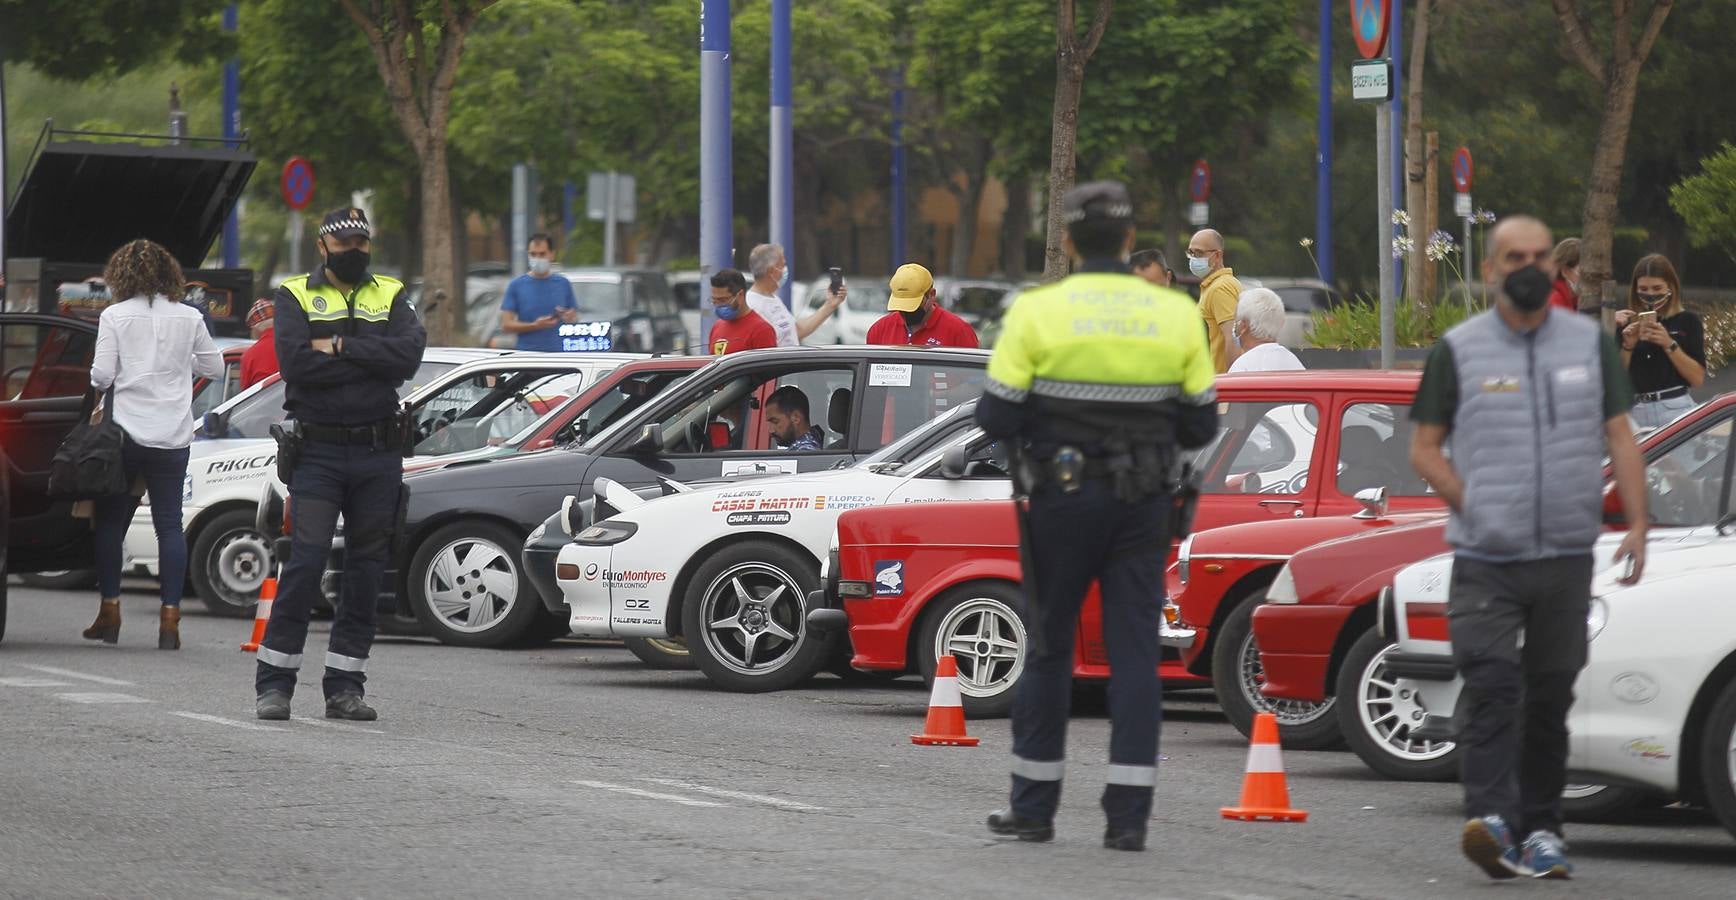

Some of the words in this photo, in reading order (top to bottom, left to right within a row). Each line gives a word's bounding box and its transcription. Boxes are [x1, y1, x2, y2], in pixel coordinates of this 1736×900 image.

[1073, 319, 1159, 337] SEVILLA
[717, 490, 763, 499] TALLERES
[711, 499, 755, 512] CASAS
[759, 497, 810, 510] MARTIN
[727, 514, 752, 523] CHAPA
[757, 513, 789, 522] PINTURA
[602, 569, 667, 583] EuroMontyres
[625, 599, 650, 609] OZ
[613, 616, 641, 624] TALLERES
